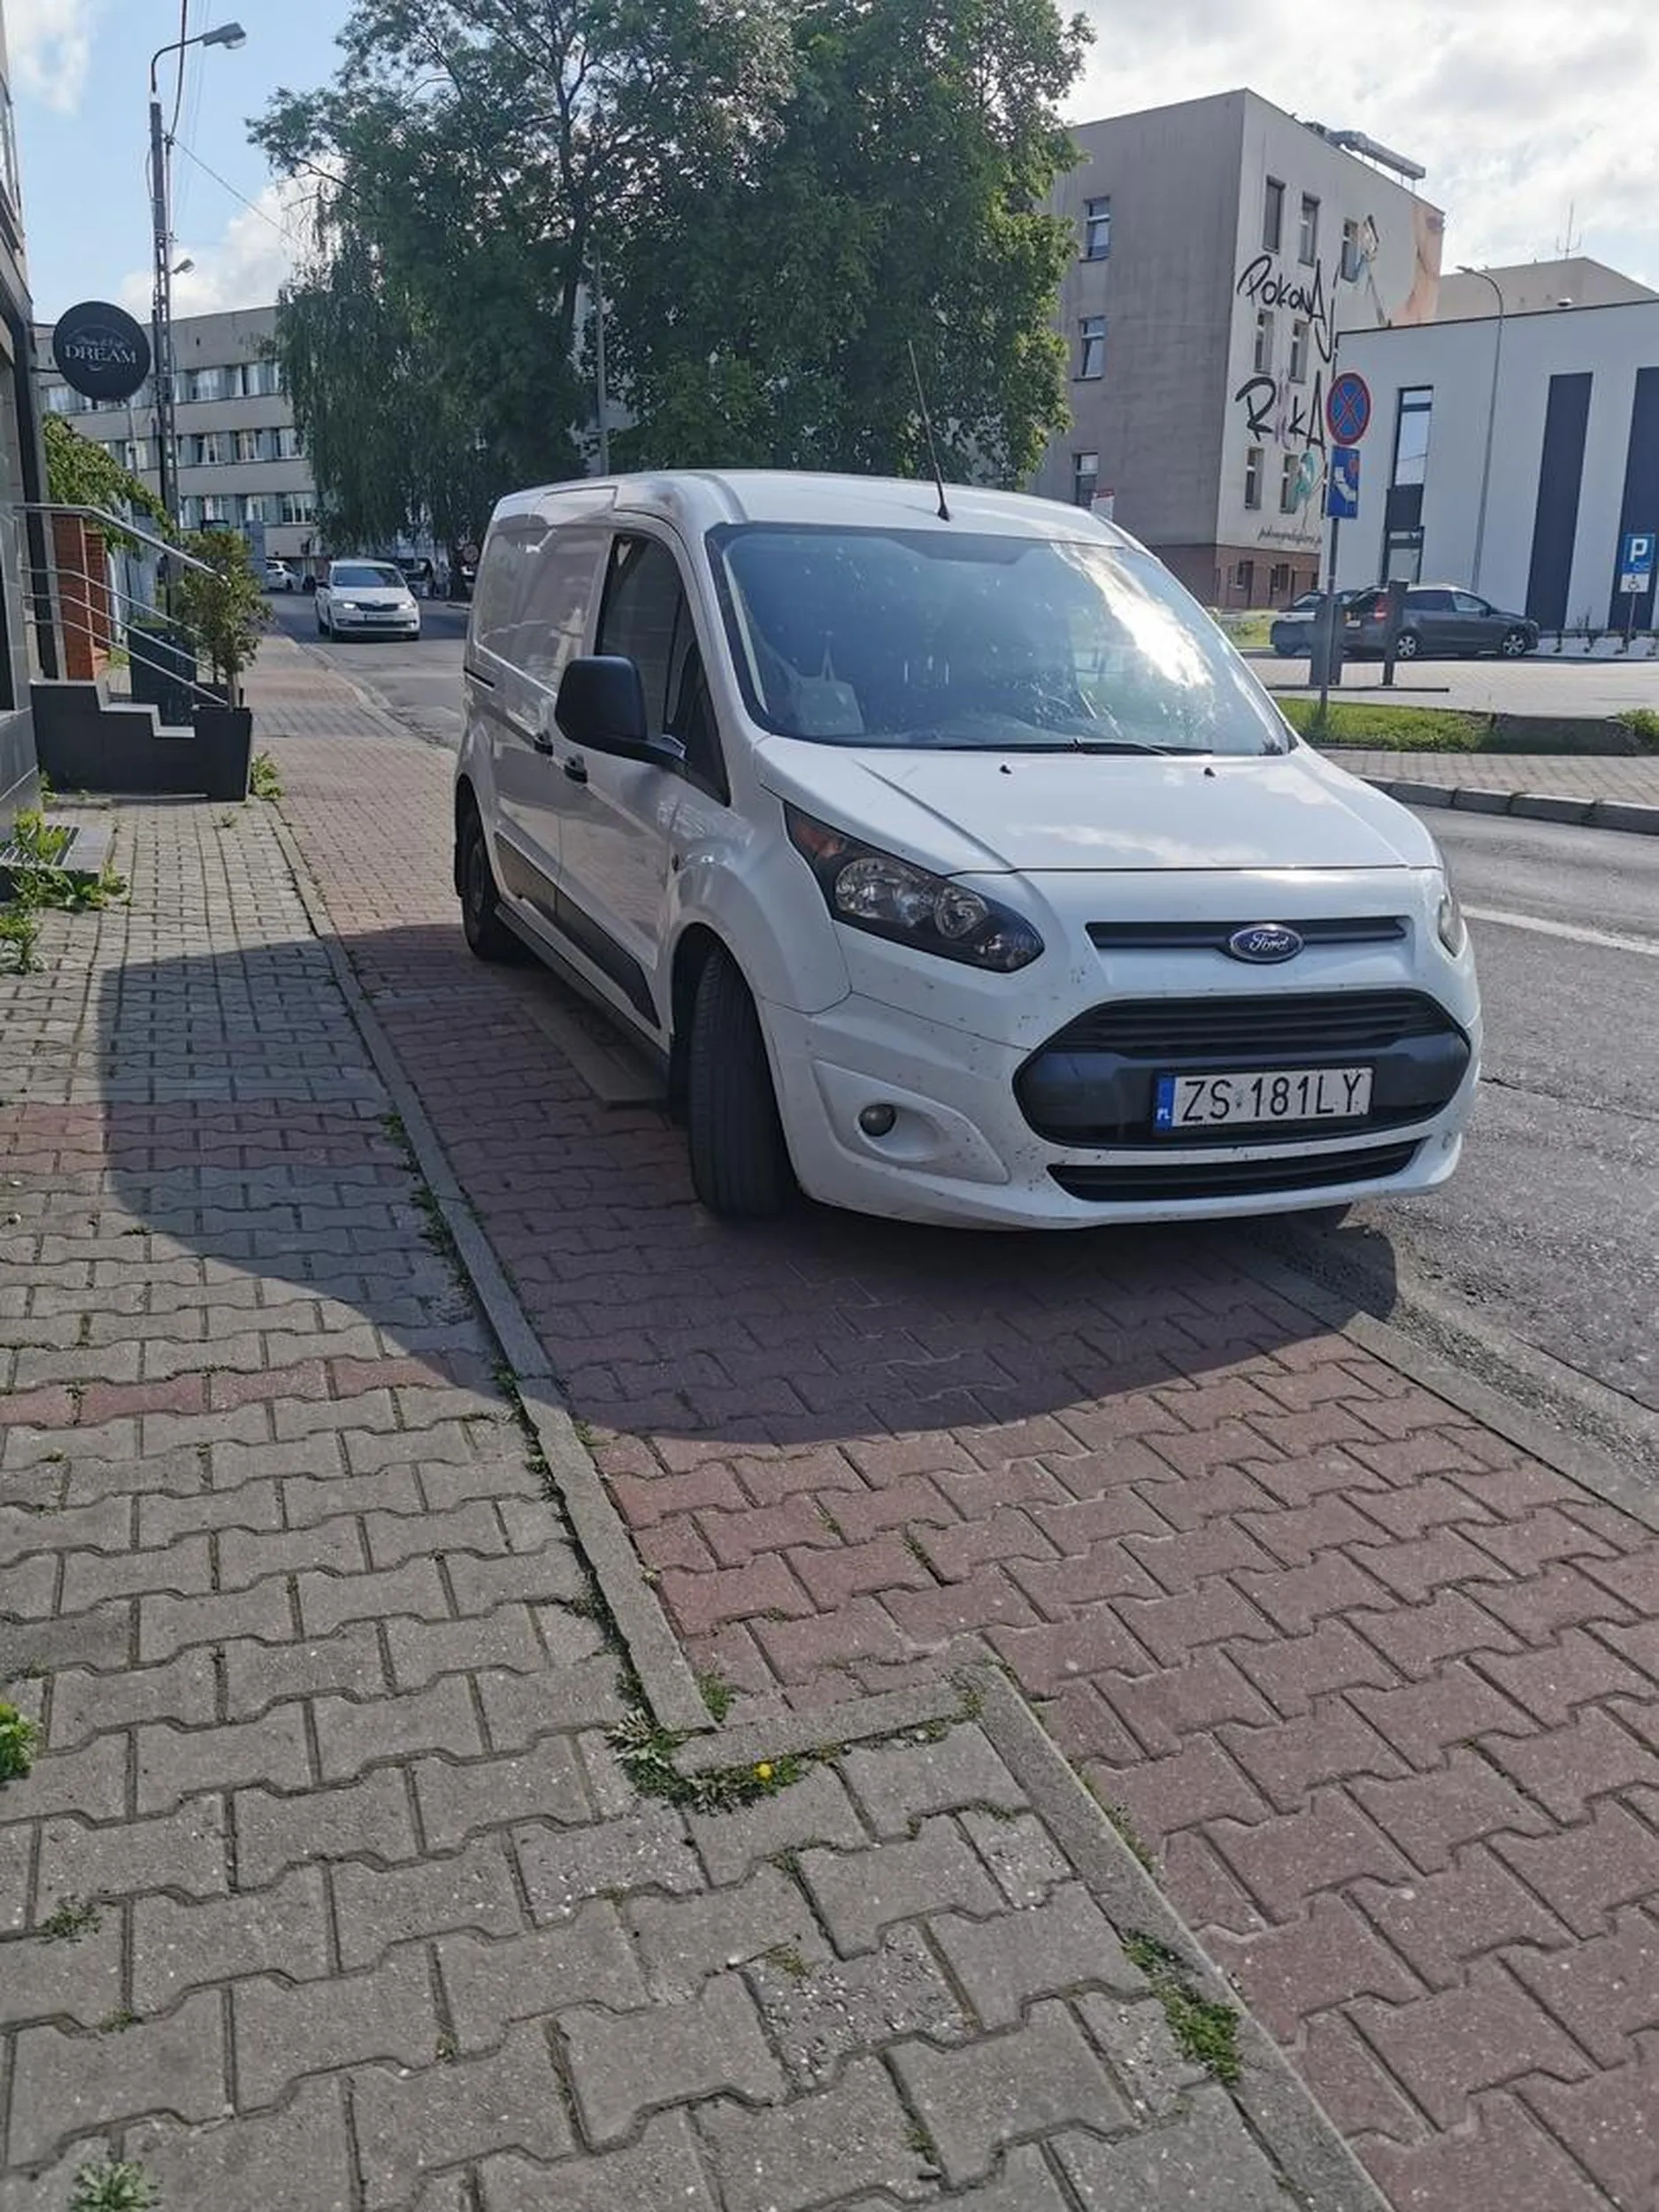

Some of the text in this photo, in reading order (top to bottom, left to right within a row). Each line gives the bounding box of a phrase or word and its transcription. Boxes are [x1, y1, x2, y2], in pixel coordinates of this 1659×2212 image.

[65, 344, 136, 364] DREAM
[1630, 538, 1648, 562] P
[1249, 932, 1289, 951] Ford
[1182, 1073, 1363, 1122] ZS 181LY
